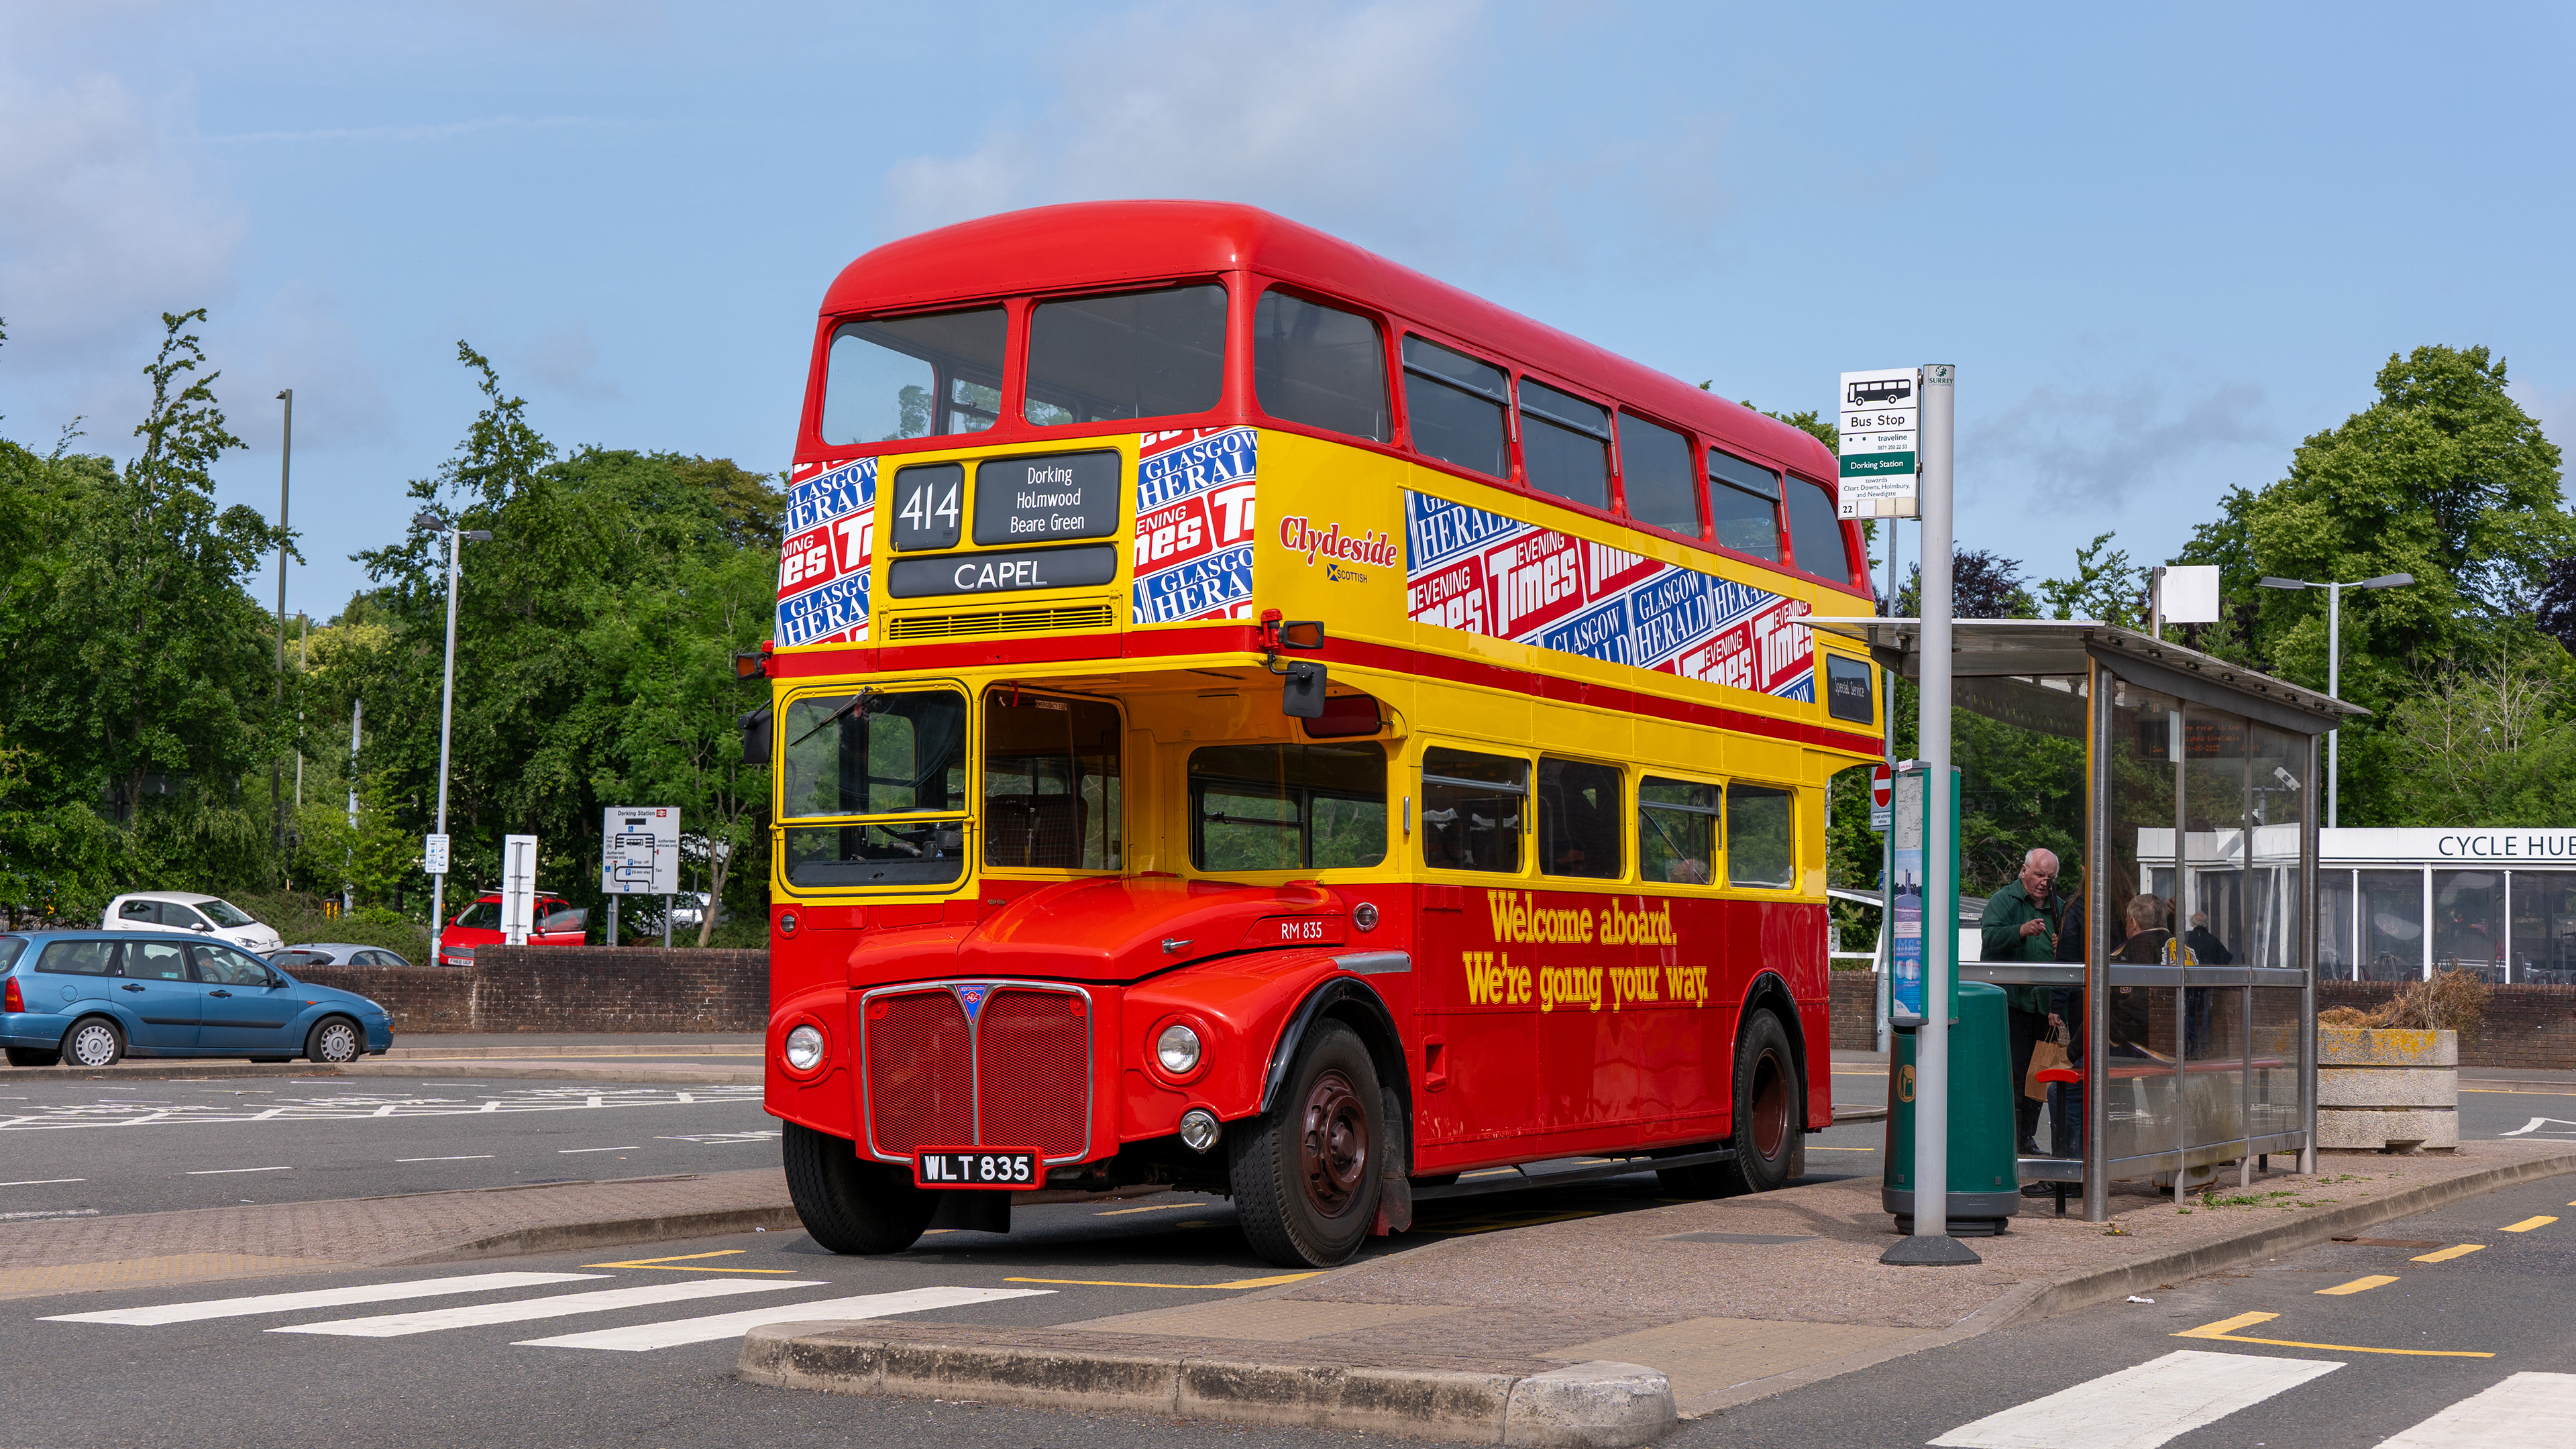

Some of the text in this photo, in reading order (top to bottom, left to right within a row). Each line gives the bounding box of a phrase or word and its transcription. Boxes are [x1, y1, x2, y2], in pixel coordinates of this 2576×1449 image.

[1851, 415, 1905, 427] Bus Stop
[1146, 431, 1258, 480] GLASGOW
[1850, 462, 1878, 470] Dorking
[1027, 466, 1073, 486] Dorking
[1138, 449, 1257, 510] HERAL
[785, 476, 877, 535] HERAL
[898, 482, 959, 531] 414
[1016, 488, 1081, 509] Holmwood
[1010, 515, 1085, 534] Beare Green
[1279, 515, 1397, 568] Clydeside
[1517, 531, 1565, 566] EVENING
[954, 560, 1049, 590] CAPEL
[1337, 570, 1368, 584] SCOTTISH
[1417, 566, 1470, 609] EVENING
[1489, 545, 1576, 637] Times
[1153, 568, 1253, 623] HERA
[1639, 571, 1699, 621] GLASGOW
[784, 591, 869, 646] HERA
[1635, 594, 1710, 663] HERALD
[1705, 629, 1743, 667] EVENING
[1835, 678, 1865, 697] Special Service
[2438, 836, 2517, 856] CYCLE
[1281, 921, 1322, 939] RM 835
[1487, 889, 1677, 946] Welcome aboard.
[1462, 951, 1708, 1014] We're going your way.
[924, 1155, 1029, 1181] WLT 835
